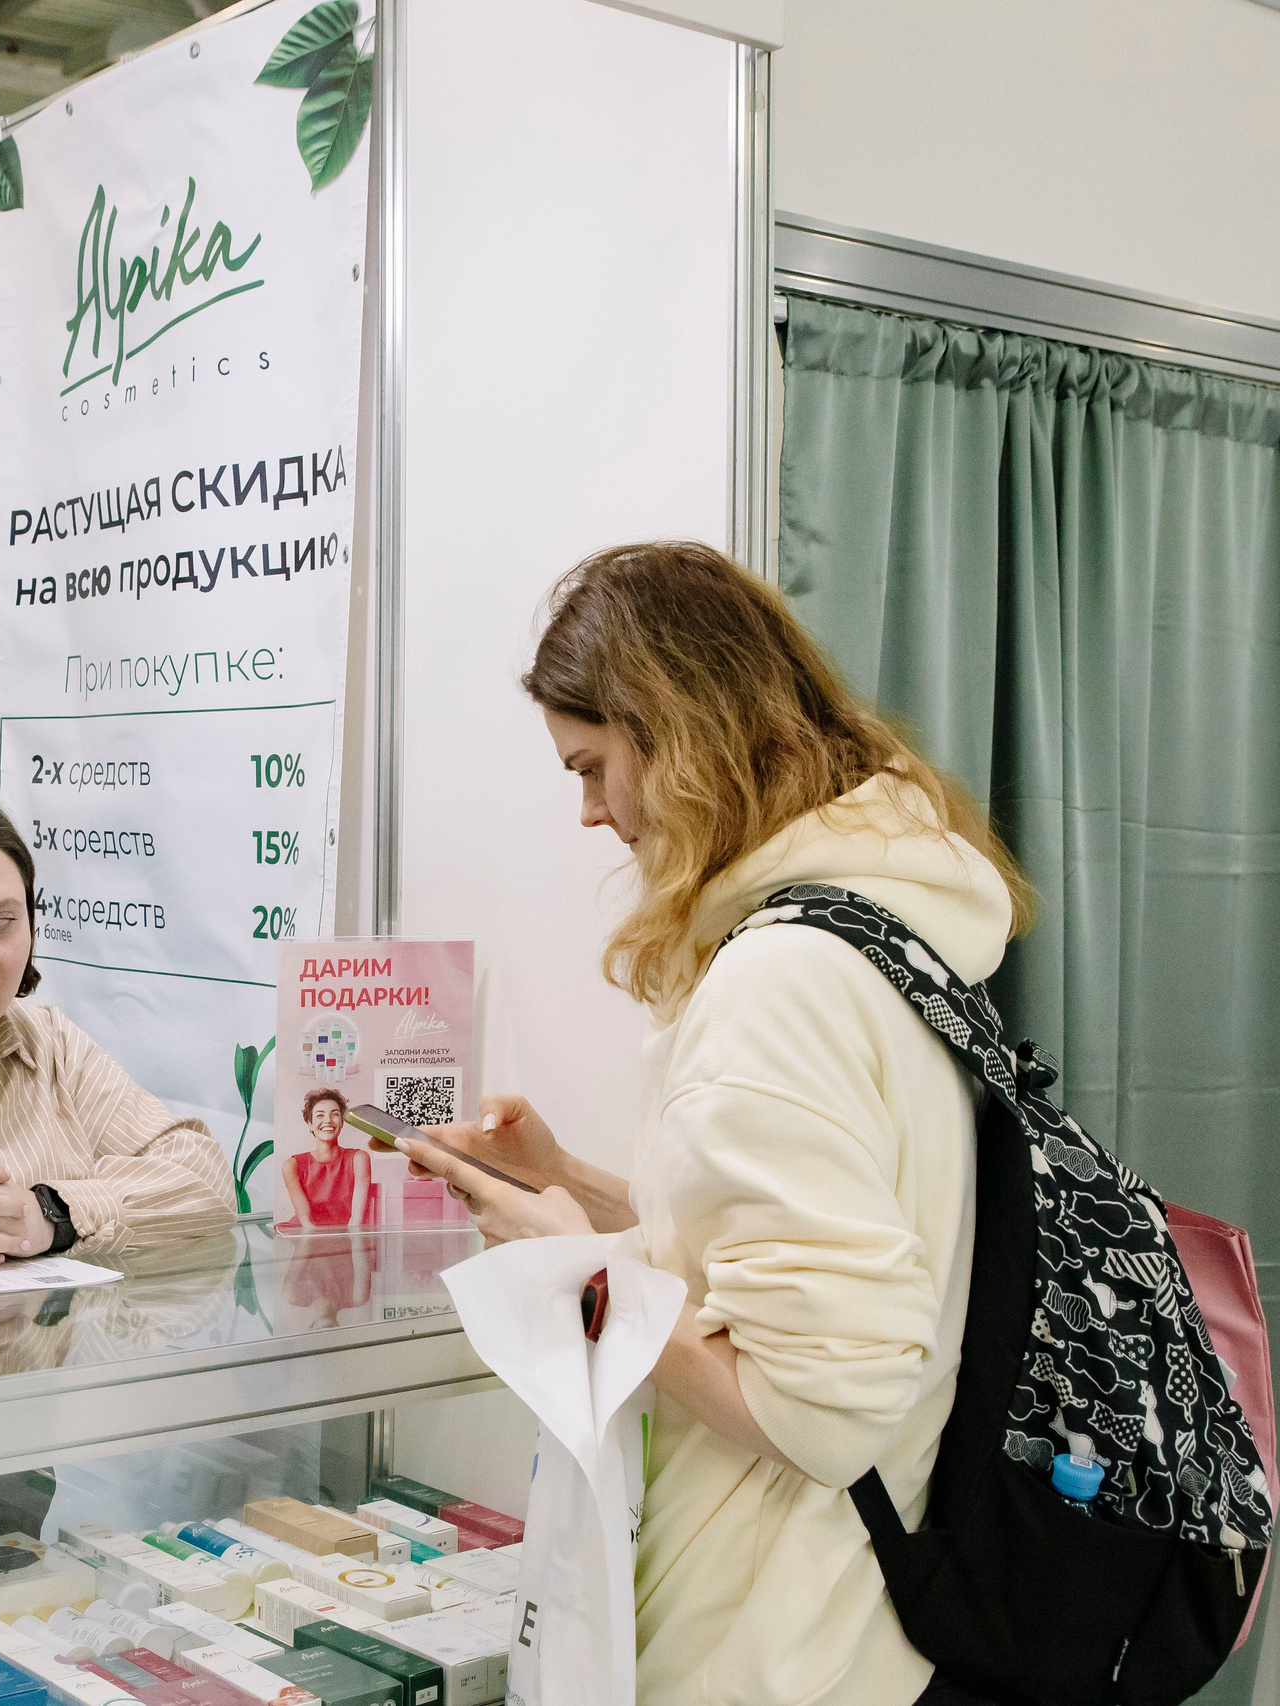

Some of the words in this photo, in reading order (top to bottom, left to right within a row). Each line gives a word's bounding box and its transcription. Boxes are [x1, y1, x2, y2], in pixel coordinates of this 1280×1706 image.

[61, 176, 263, 387] Alpika
[61, 351, 271, 422] cosmetics
[10, 477, 161, 546] РАСТУЩАЯ
[171, 445, 347, 513] СКИДКА
[16, 576, 57, 606] на
[66, 565, 111, 602] всю
[120, 532, 338, 601] продукцию
[65, 655, 112, 702] При
[120, 647, 283, 696] покупке:
[31, 754, 65, 785] 2-х
[69, 761, 151, 792] средств
[250, 753, 305, 789] 10%
[33, 819, 58, 851] 3-х
[62, 828, 155, 860] средств
[252, 830, 300, 865] 15%
[66, 897, 166, 931] средств
[252, 905, 298, 941] 20%
[44, 923, 72, 943] более
[299, 957, 392, 982] ДАРИМ
[300, 987, 430, 1011] ПОДАРКИ!
[394, 1009, 451, 1040] Alpika
[387, 1057, 418, 1065] ПОЛУЧИ
[419, 1056, 456, 1065] ПОДАРОК
[422, 1048, 450, 1056] АНКЕТУ
